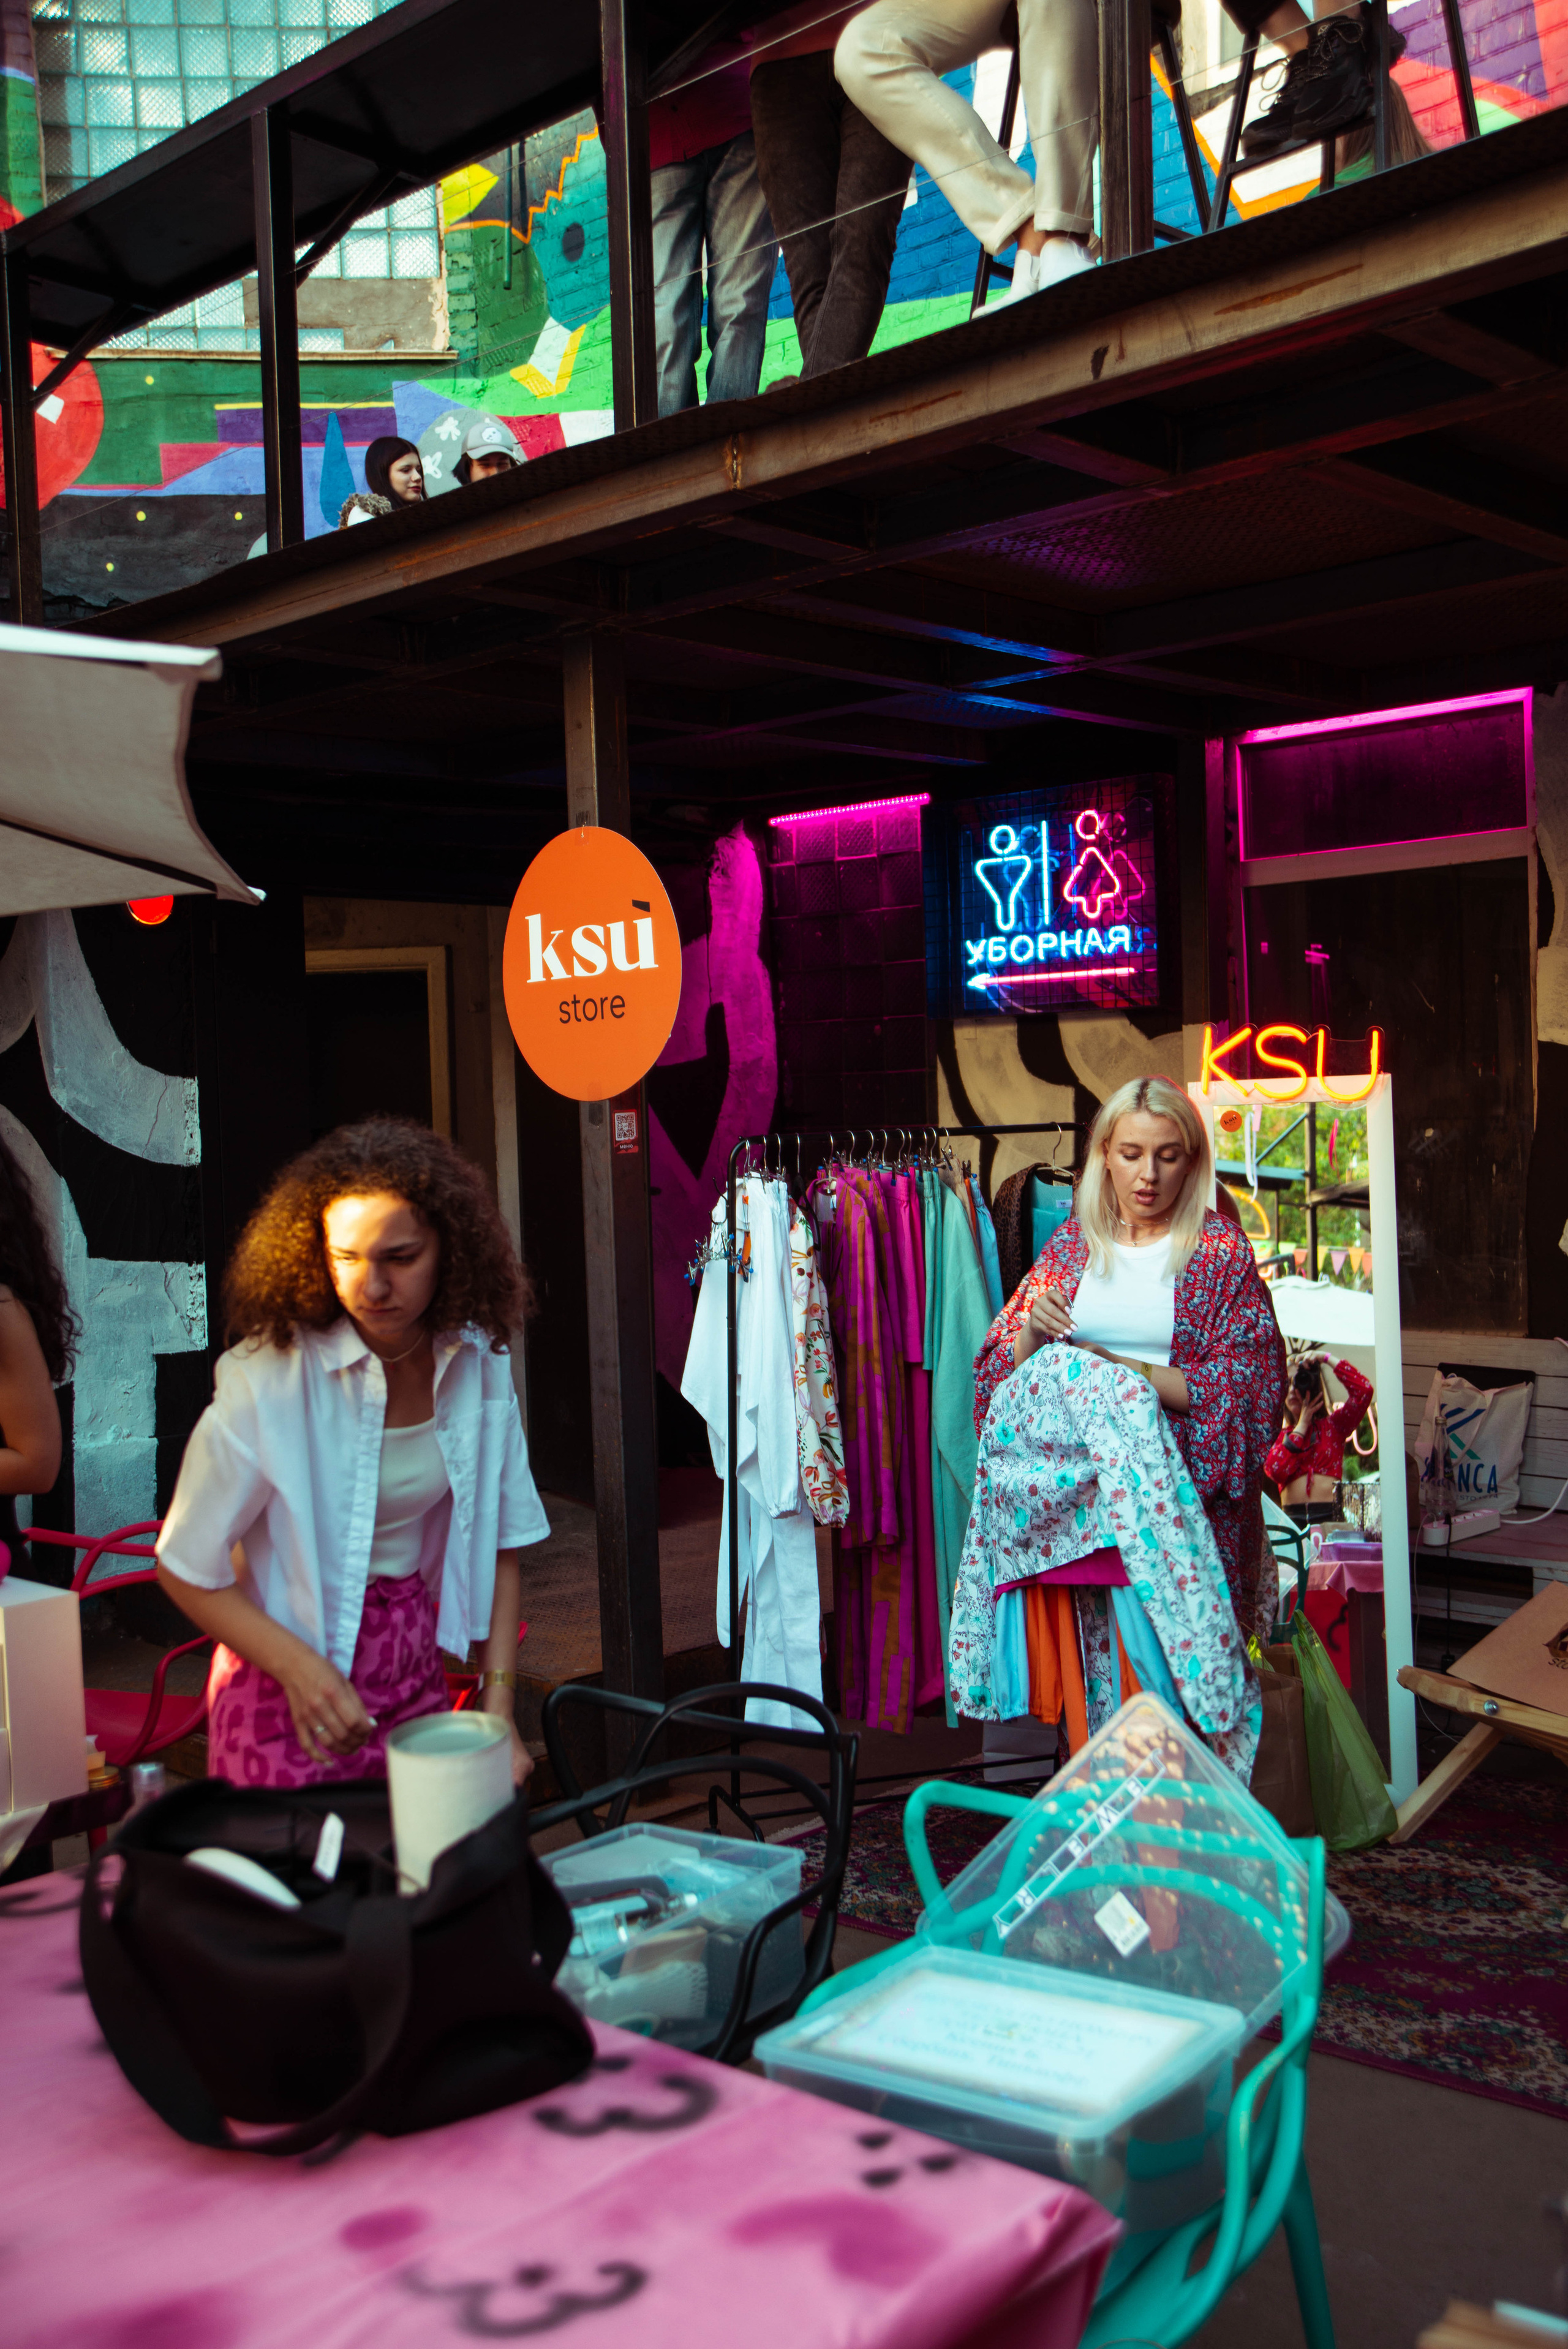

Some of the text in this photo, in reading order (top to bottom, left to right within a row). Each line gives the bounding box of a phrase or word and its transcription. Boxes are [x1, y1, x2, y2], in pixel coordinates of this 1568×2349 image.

[965, 925, 1131, 965] УБОРНАЯ
[559, 994, 626, 1024] store
[1200, 1025, 1379, 1101] KSU
[993, 1748, 1166, 1939] JEWELRY
